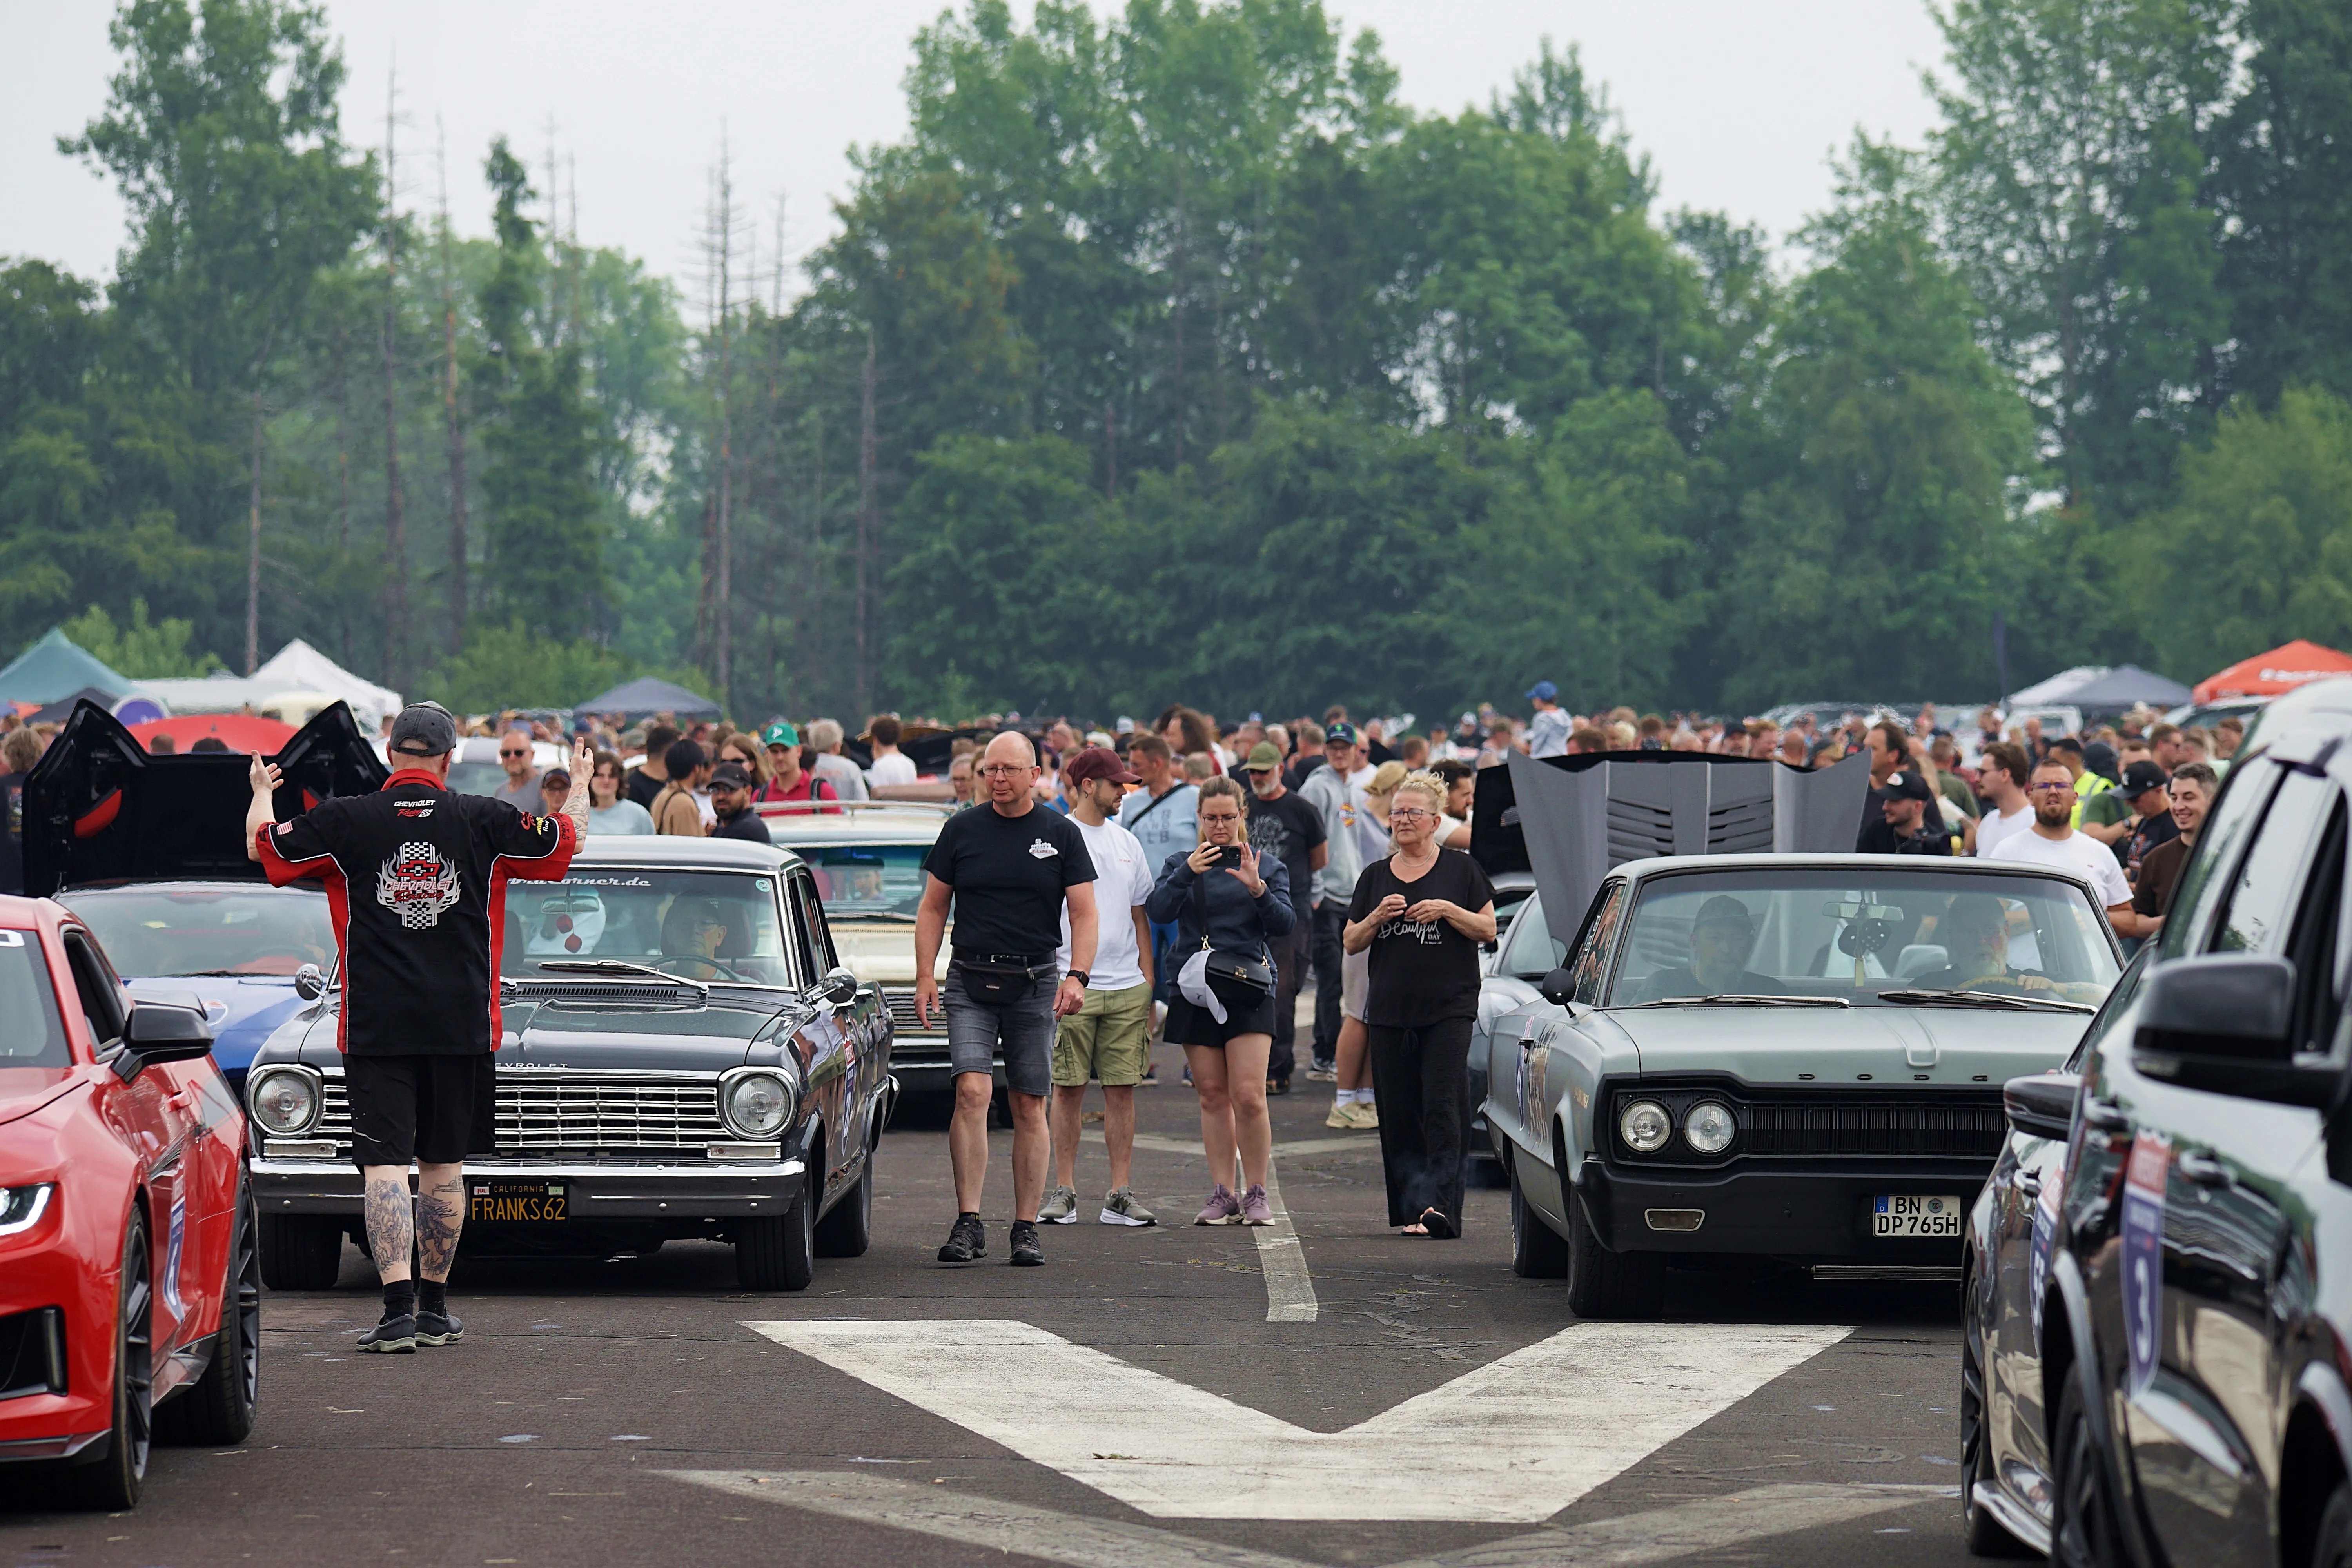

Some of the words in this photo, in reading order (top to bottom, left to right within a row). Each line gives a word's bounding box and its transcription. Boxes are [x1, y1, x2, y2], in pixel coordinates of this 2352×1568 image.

[384, 880, 453, 891] CHEVROLET
[394, 890, 445, 903] Racing
[1895, 1197, 1921, 1214] BN
[1877, 1216, 1903, 1234] DP
[1907, 1216, 1958, 1234] 765H
